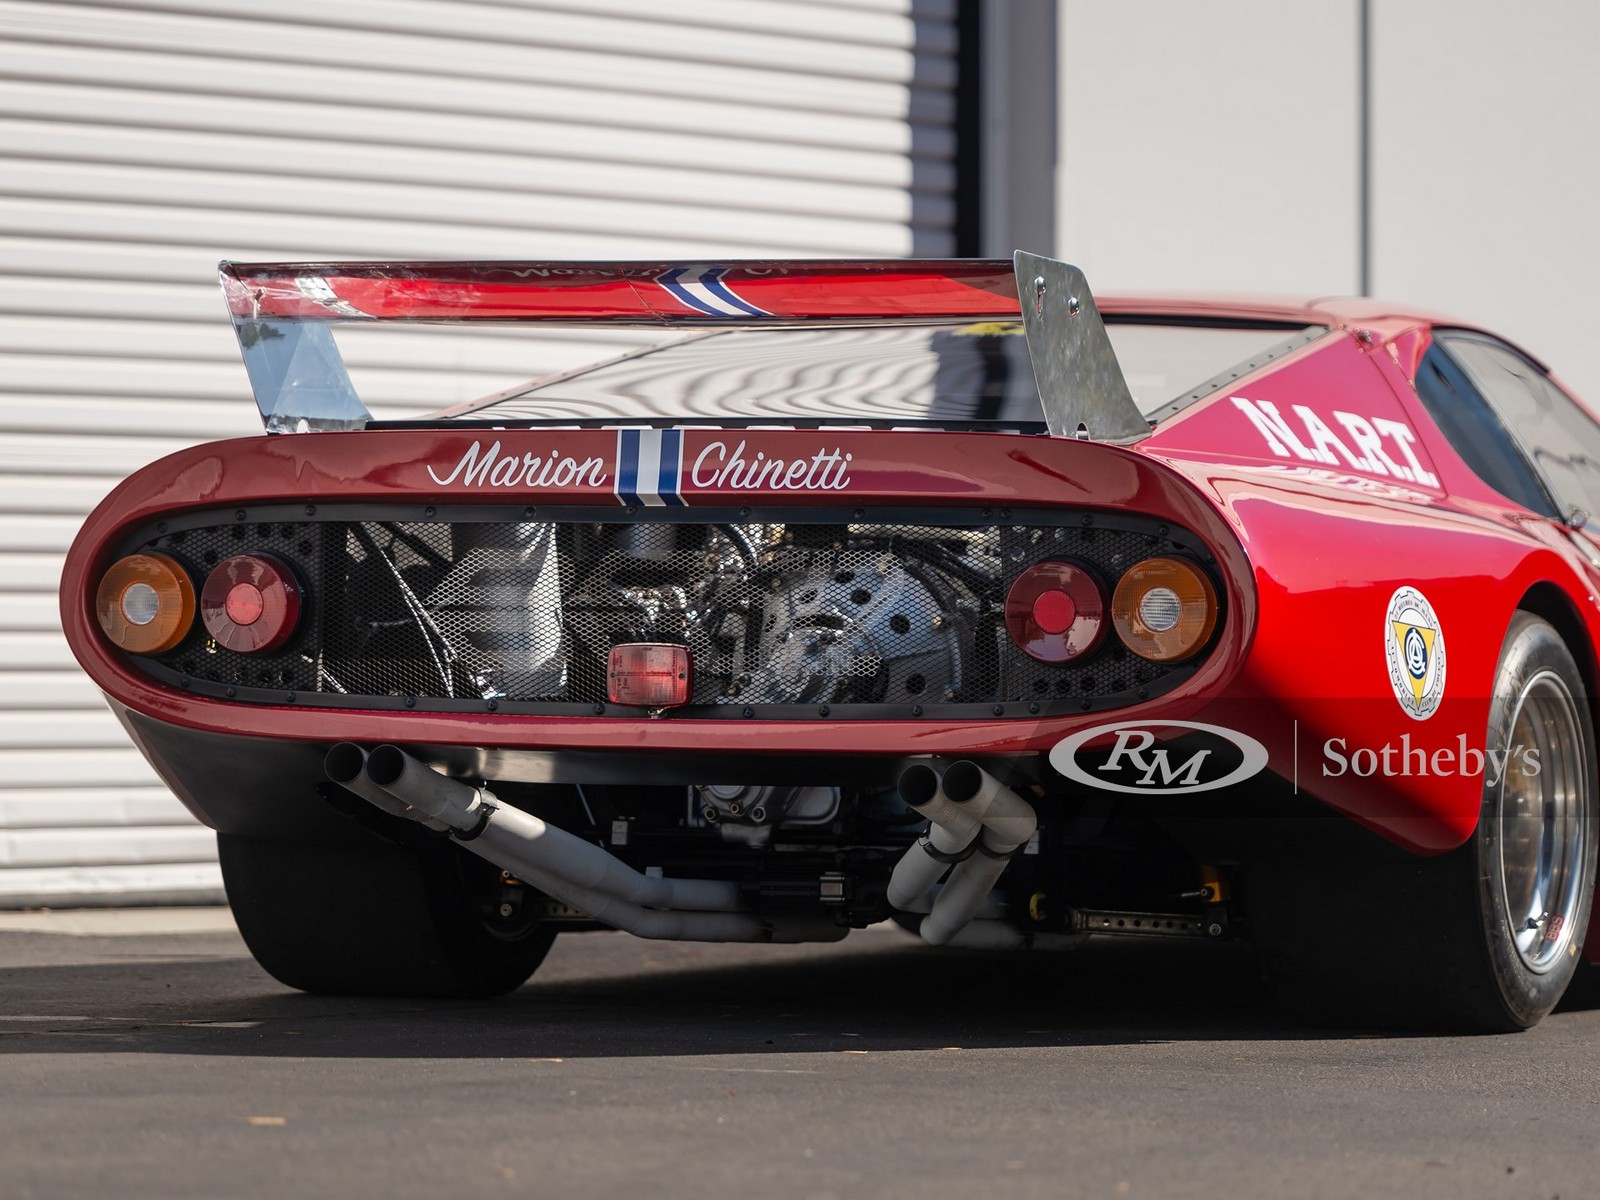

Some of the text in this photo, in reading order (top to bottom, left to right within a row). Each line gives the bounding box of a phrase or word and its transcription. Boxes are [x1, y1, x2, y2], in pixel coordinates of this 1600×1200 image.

[426, 440, 853, 490] Marion Chinetti
[1546, 914, 1564, 941] BBS
